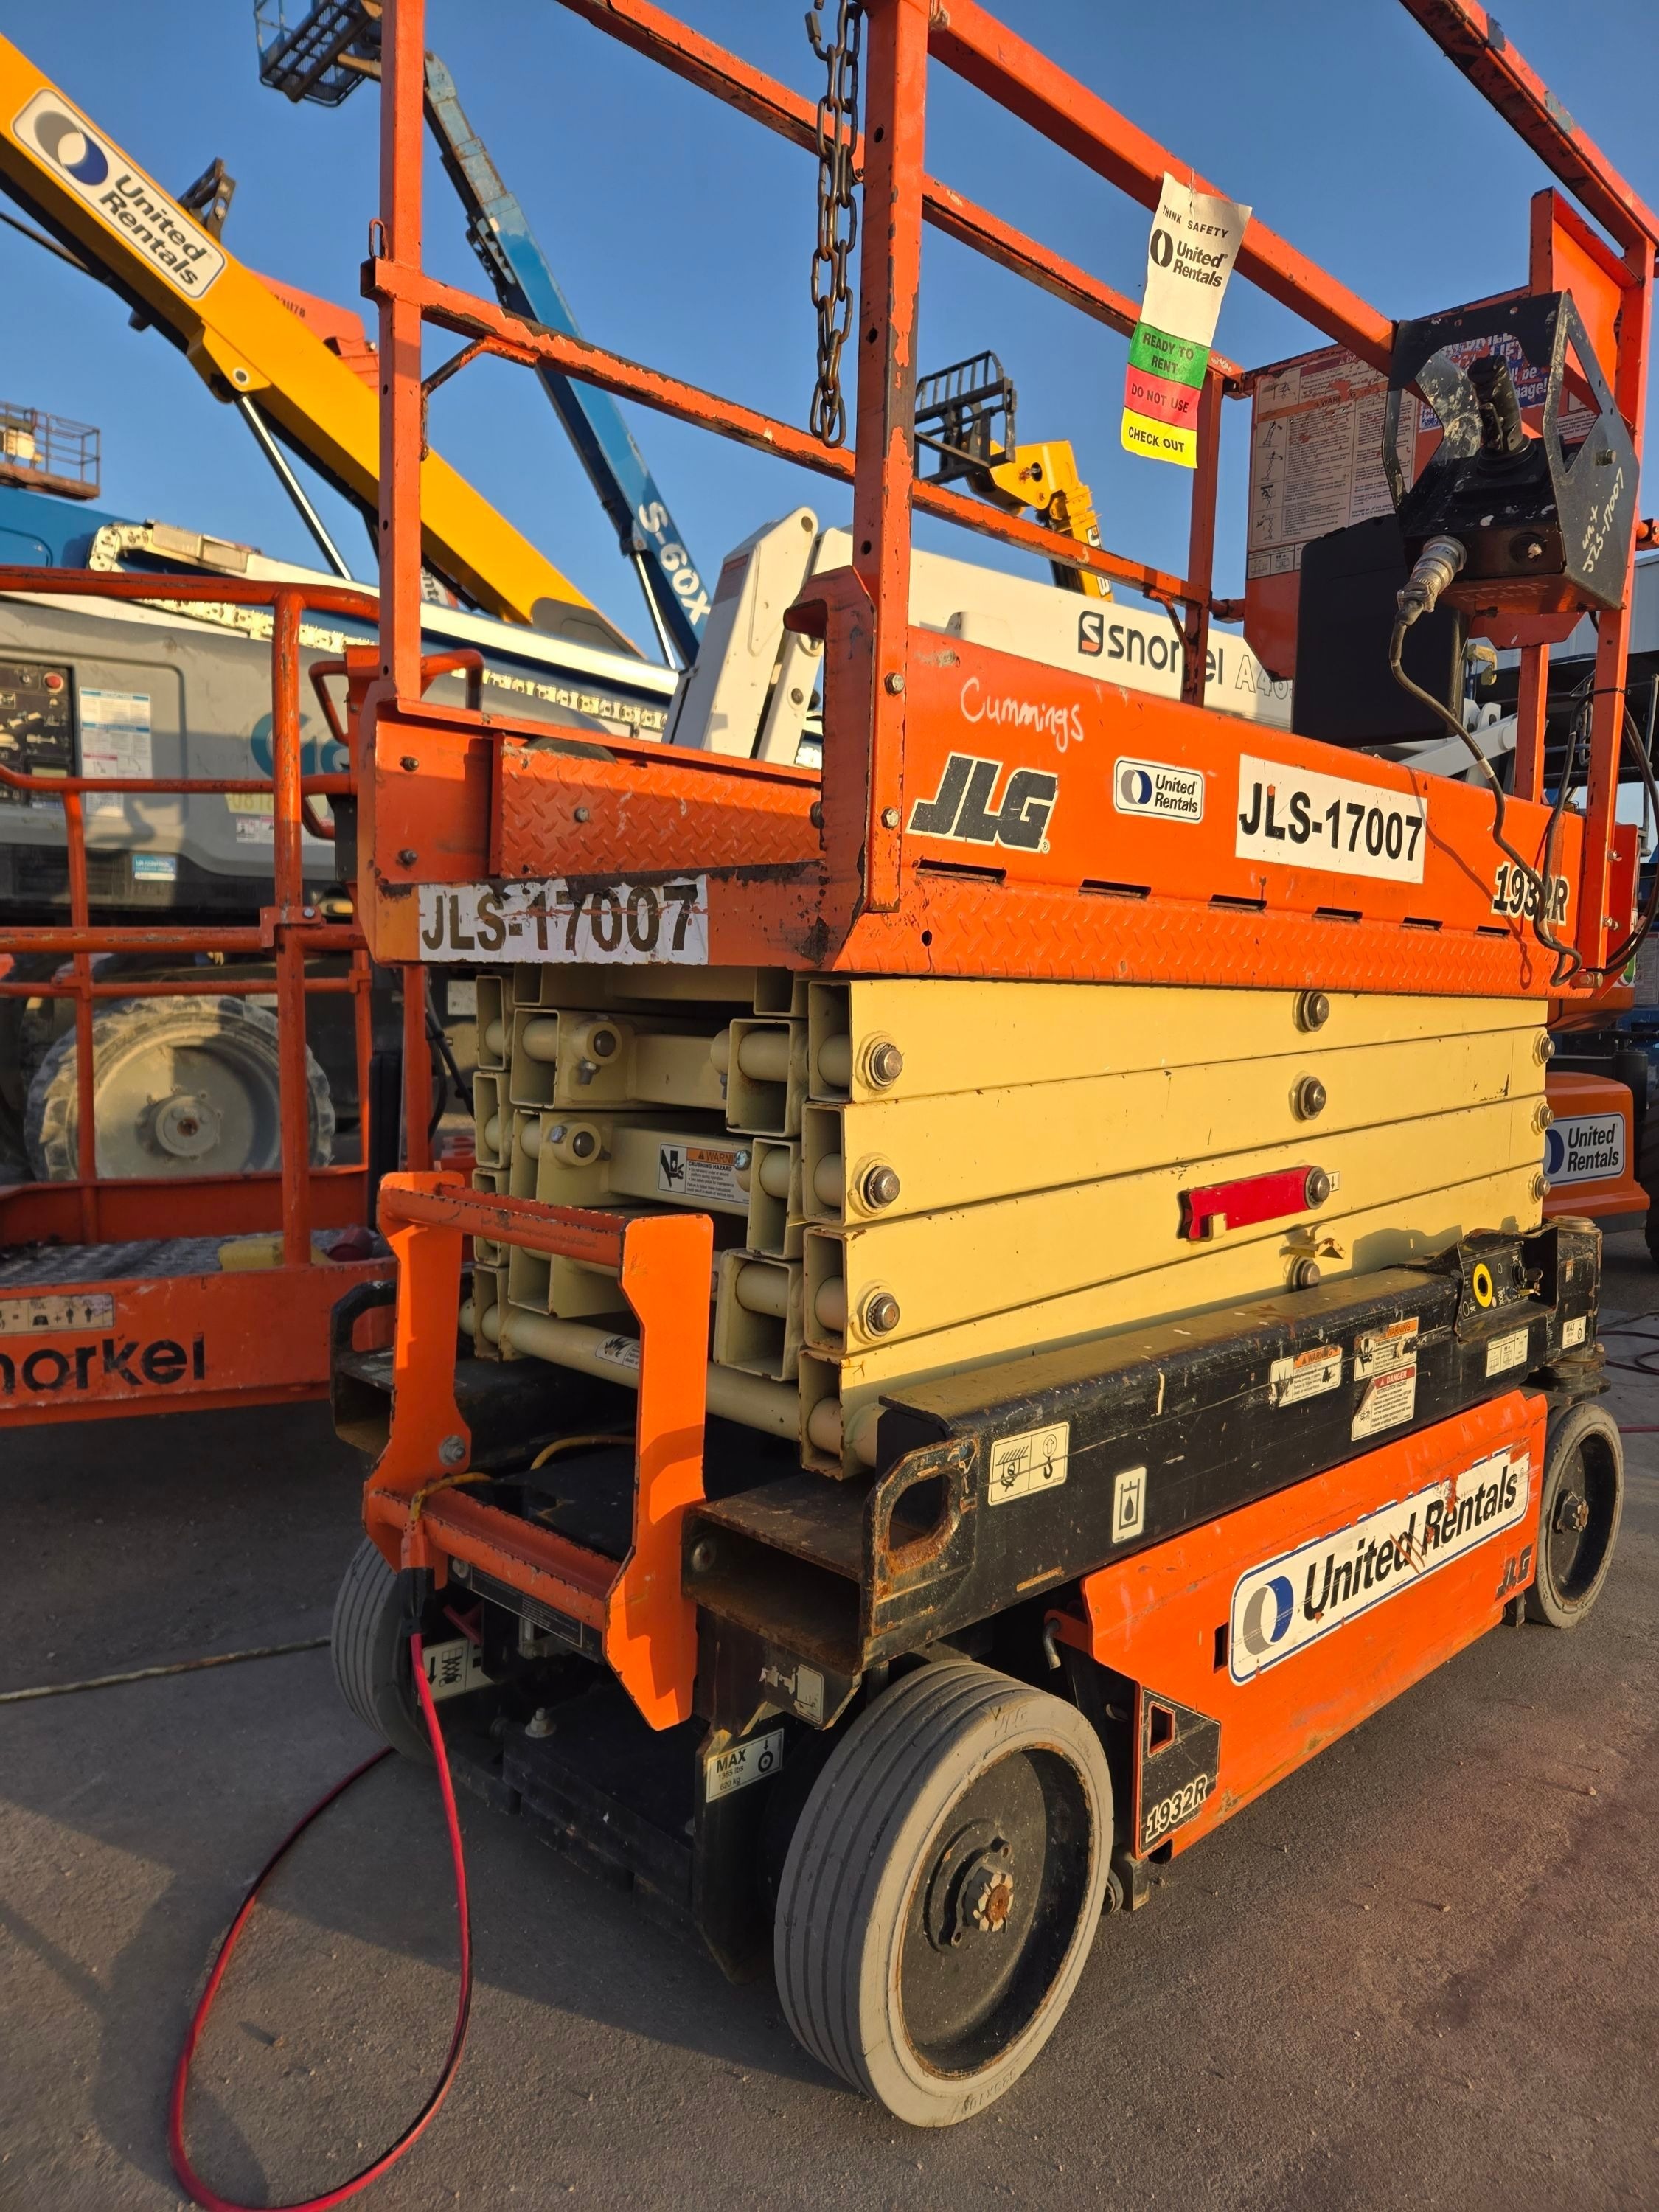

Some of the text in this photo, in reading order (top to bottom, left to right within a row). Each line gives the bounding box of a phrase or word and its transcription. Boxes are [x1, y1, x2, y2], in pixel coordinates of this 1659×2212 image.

[115, 174, 208, 261] United
[1162, 204, 1229, 238] THINK SAFETY
[98, 190, 198, 285] Rentals
[1177, 240, 1225, 268] United
[1172, 259, 1223, 288] Rentals
[1143, 333, 1194, 361] READY TO
[1151, 355, 1179, 375] RENT
[1131, 383, 1189, 414] DO NOT USE
[1128, 426, 1185, 453] CHECK OUT
[639, 501, 712, 626] S-60X
[1108, 625, 1224, 685] snorel
[960, 676, 1084, 753] Cummings
[1155, 774, 1195, 796] United
[905, 753, 1058, 853] JLG
[1154, 793, 1198, 813] Rentals
[1239, 782, 1423, 862] JLS-17007
[422, 883, 698, 953] JLS-17007
[1568, 1123, 1615, 1148] United
[1567, 1147, 1619, 1172] Rentals
[1565, 1323, 1575, 1333] MAX
[1386, 1370, 1408, 1385] DANGER
[1304, 1465, 1518, 1621] United Rentals
[716, 1748, 746, 1773] MAX
[1145, 1774, 1208, 1843] 1932R
